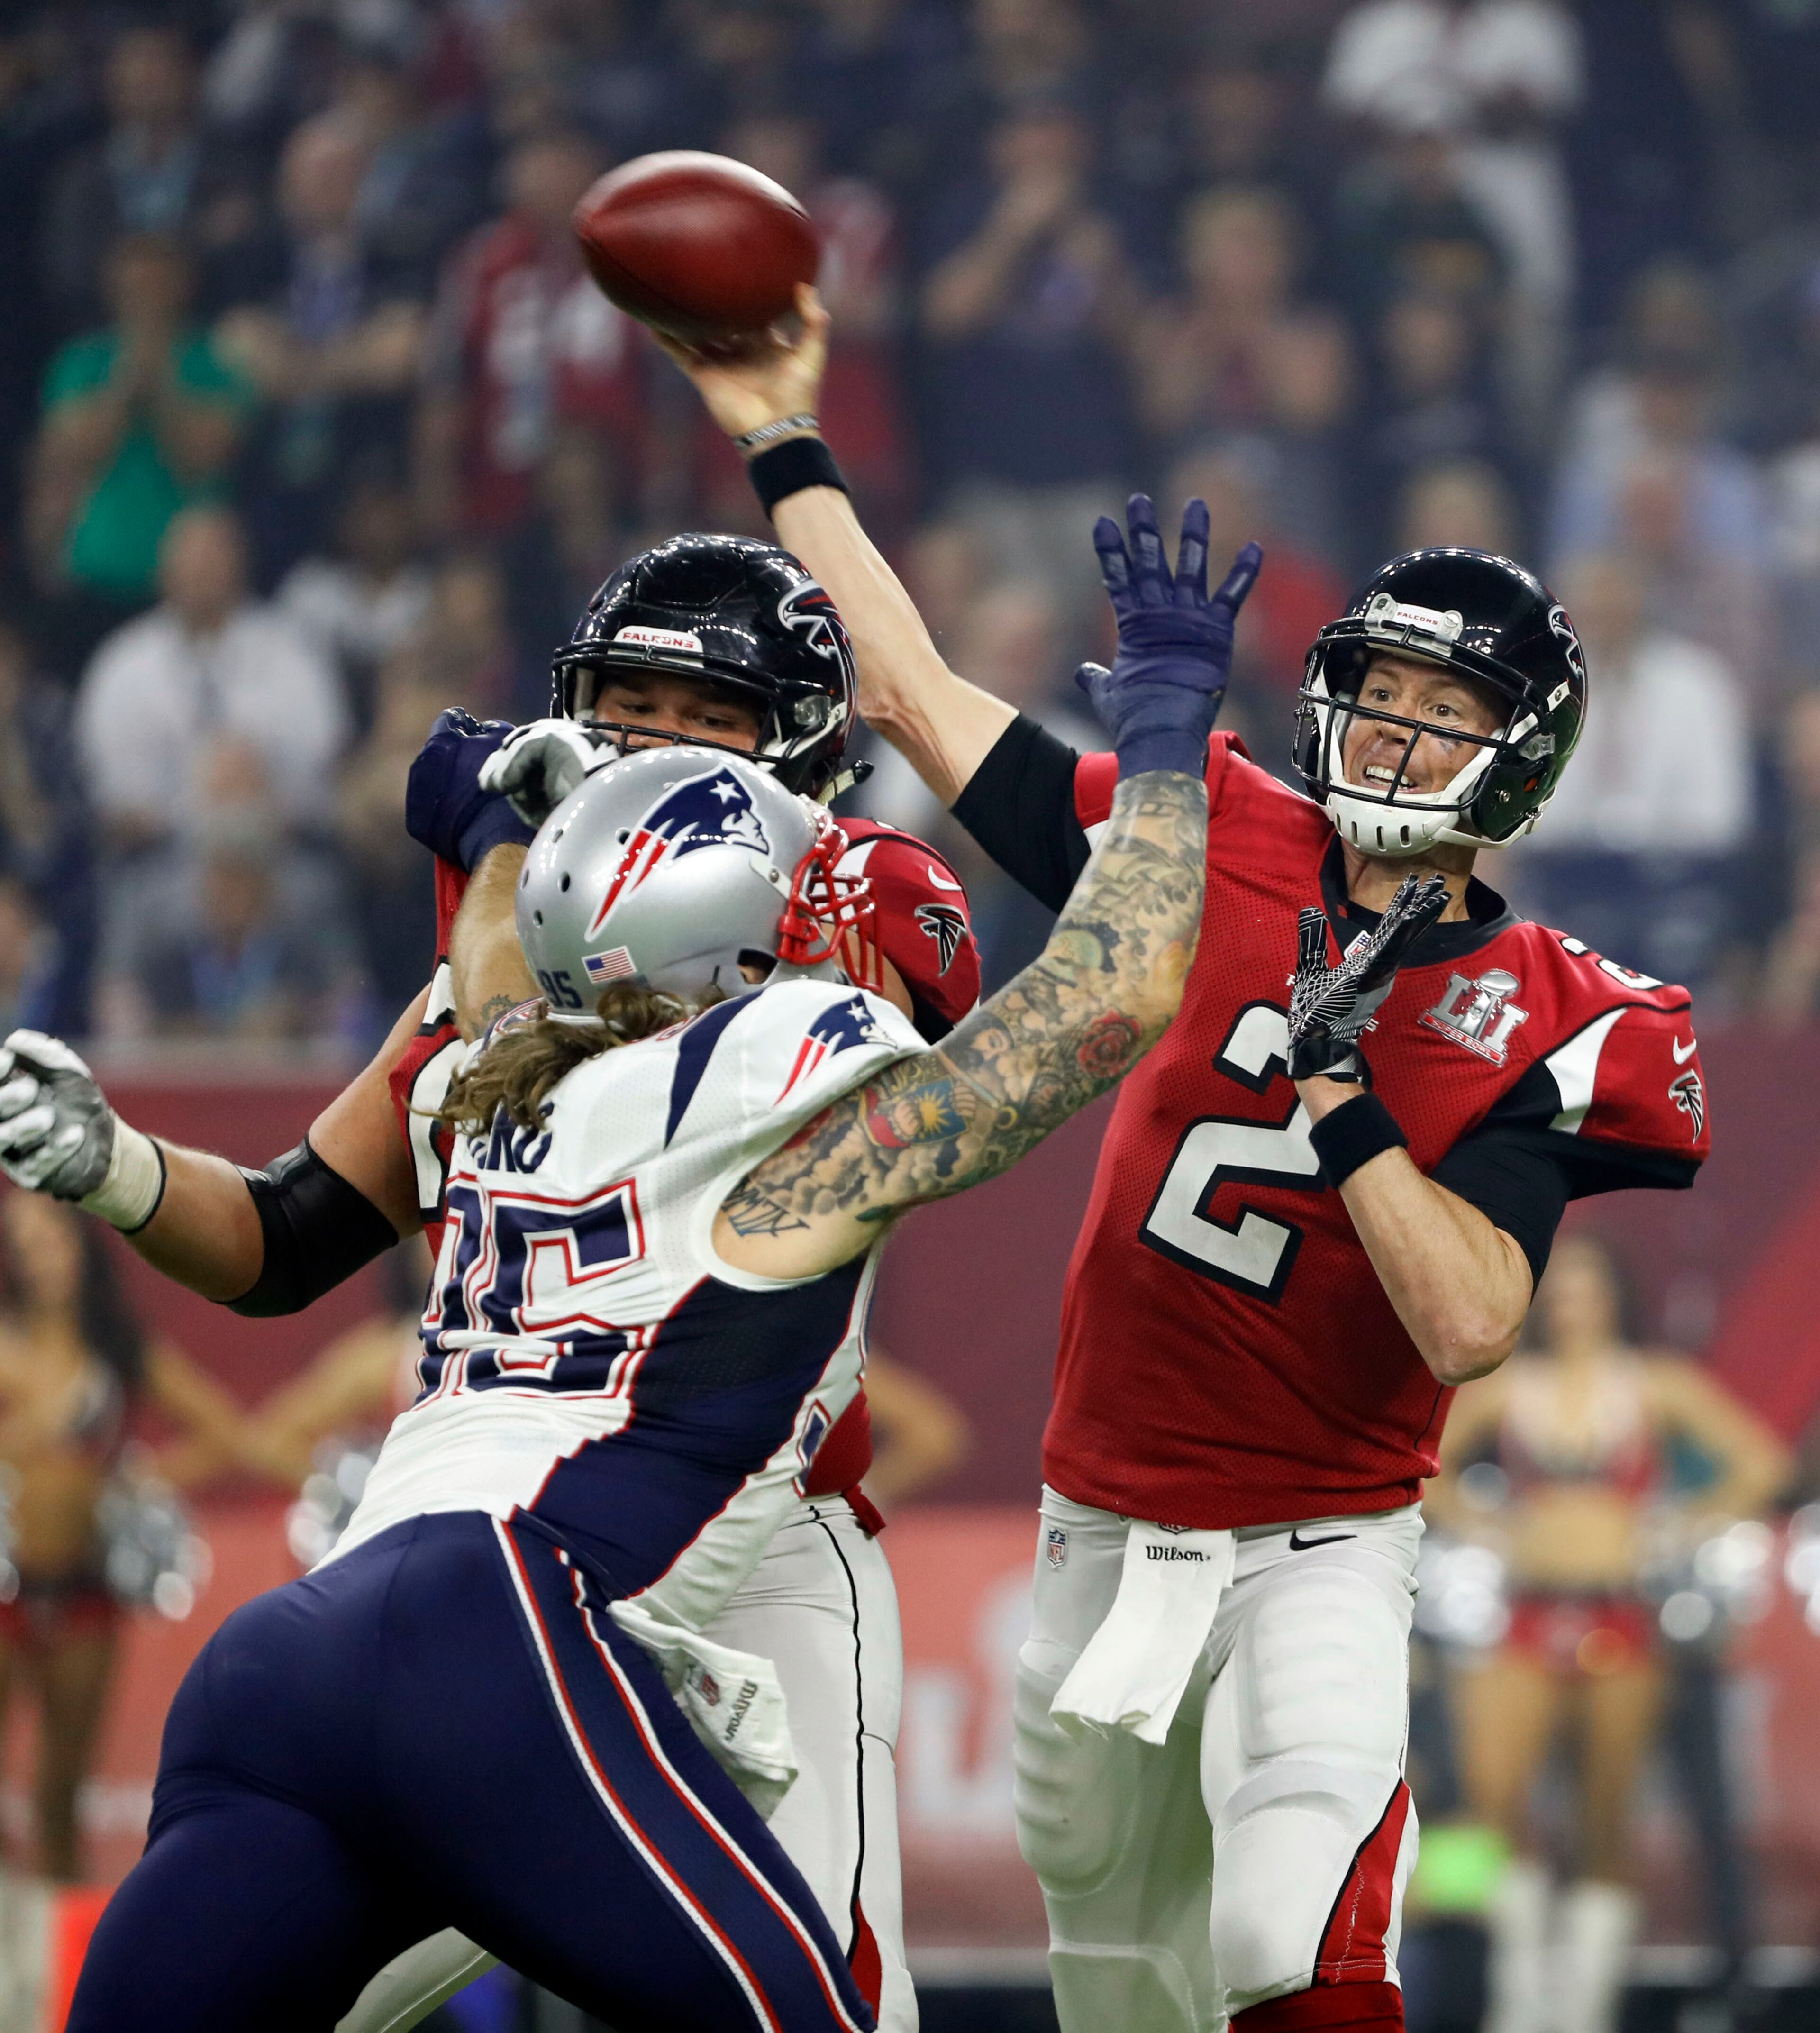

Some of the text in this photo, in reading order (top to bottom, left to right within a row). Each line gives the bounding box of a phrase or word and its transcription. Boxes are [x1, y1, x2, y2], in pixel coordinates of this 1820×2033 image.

[1397, 611, 1438, 625] FALCONS
[623, 632, 693, 648] FALCONS
[537, 969, 583, 1009] 95
[1431, 1018, 1492, 1058] SUPER BOWL
[1140, 1001, 1325, 1304] 2
[1146, 1545, 1204, 1562] Wilson
